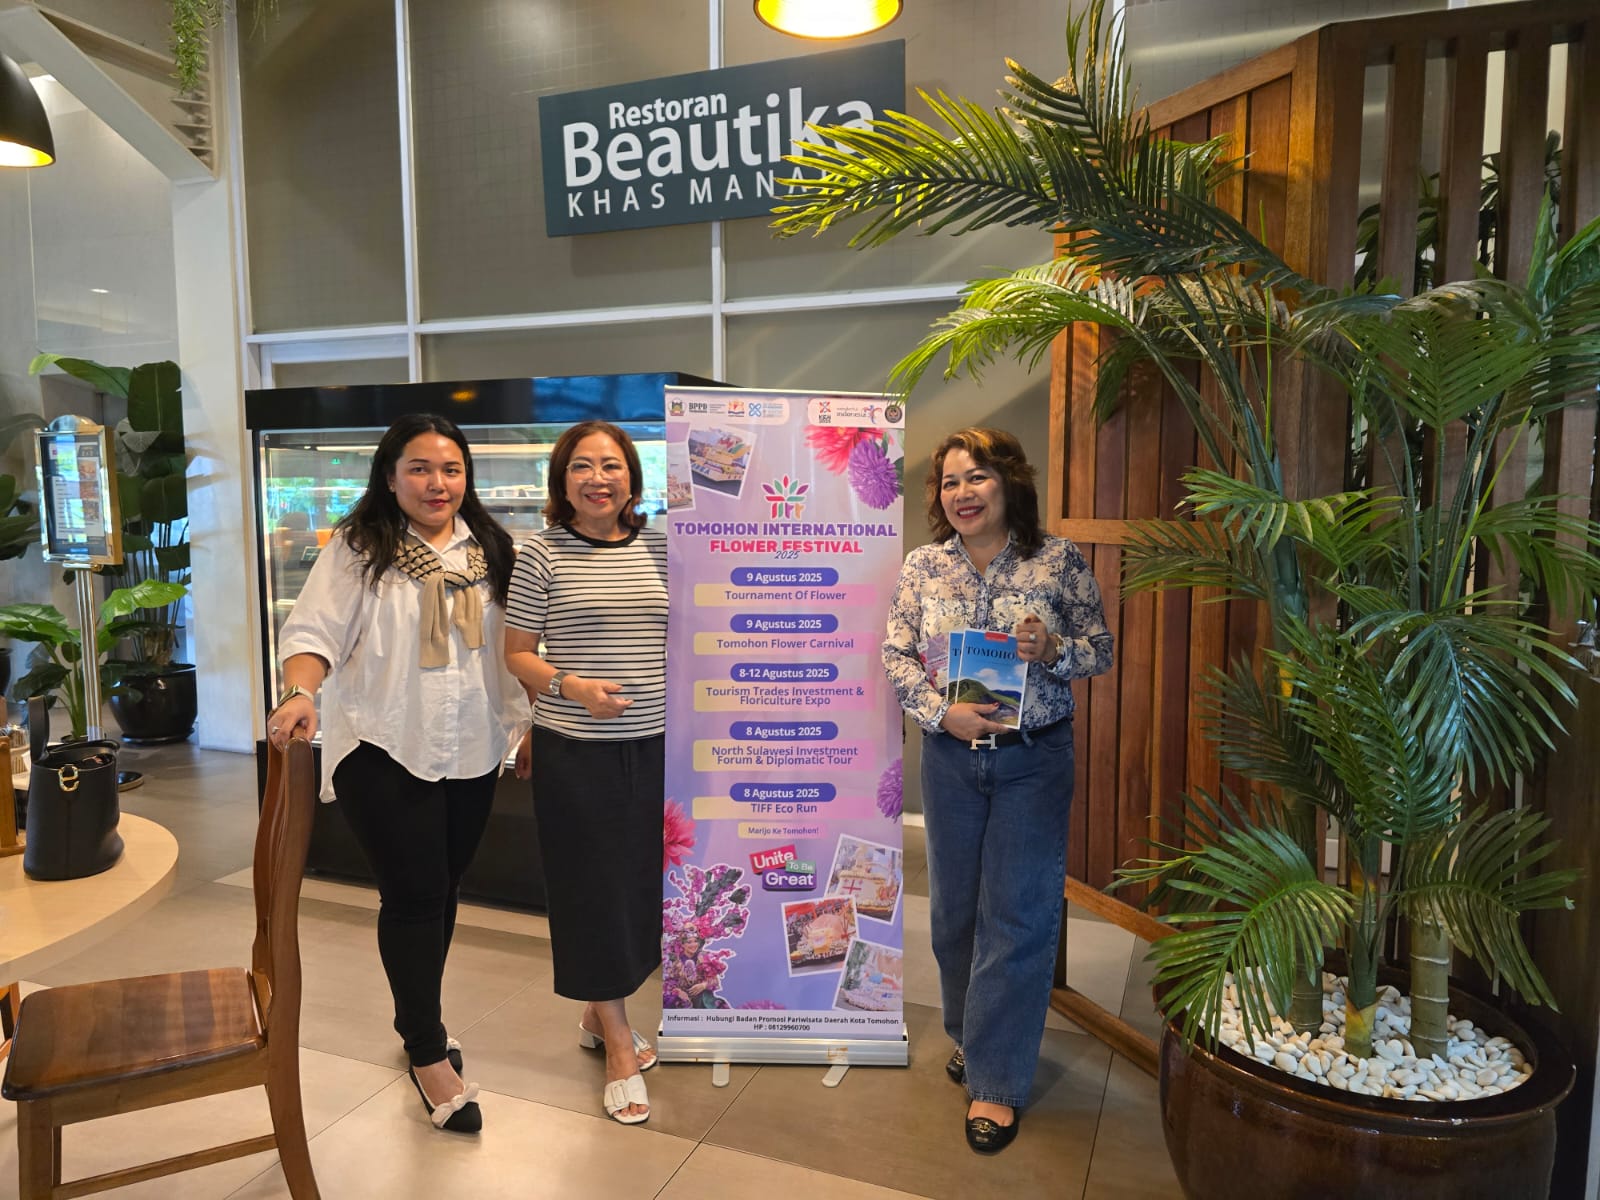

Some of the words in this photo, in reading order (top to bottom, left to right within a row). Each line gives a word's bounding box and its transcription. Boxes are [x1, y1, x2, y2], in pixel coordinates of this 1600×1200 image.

[609, 93, 728, 129] Restoran
[563, 87, 875, 187] Beautika
[568, 182, 665, 218] KHAS
[689, 167, 827, 205] MANA
[674, 522, 758, 535] TOMOHON
[763, 523, 897, 537] INTERNATIONAL
[710, 540, 777, 553] FLOWER
[782, 540, 863, 553] FESTIVAL
[774, 550, 800, 559] 2025
[746, 573, 753, 582] 9
[755, 573, 796, 584] Agustus
[799, 573, 822, 582] 2025
[724, 590, 792, 600] Tournament
[795, 590, 808, 600] Of
[810, 590, 846, 600] Flower
[746, 620, 753, 629] 9
[755, 620, 796, 631] Agustus
[798, 620, 822, 629] 2025
[717, 639, 768, 648] Tomohon
[771, 639, 807, 648] Flower
[810, 639, 854, 648] Carnival
[739, 669, 760, 678] 8-12
[762, 669, 804, 680] Agustus
[806, 669, 830, 678] 2025
[706, 687, 750, 696] Tourism
[753, 687, 789, 696] Trades
[792, 687, 853, 696] Investment
[856, 687, 864, 695] &
[740, 695, 802, 705] Floriculture
[805, 696, 831, 707] Expo
[746, 727, 753, 736] 8
[754, 727, 796, 738] Agustus
[798, 727, 822, 736] 2025
[711, 746, 744, 756] North
[746, 746, 793, 756] Sulawesi
[796, 746, 858, 756] Investment
[717, 756, 752, 765] Forum
[755, 756, 763, 765] &
[766, 755, 824, 767] Diplomatic
[827, 755, 852, 764] Tour
[744, 789, 751, 797] 8
[752, 789, 794, 800] Agustus
[796, 789, 820, 798] 2025
[751, 803, 772, 813] TIFF
[775, 804, 794, 813] Eco
[796, 804, 817, 813] Run
[753, 850, 794, 869] Unite
[789, 861, 799, 870] To
[801, 862, 813, 871] Be
[765, 872, 814, 885] Great
